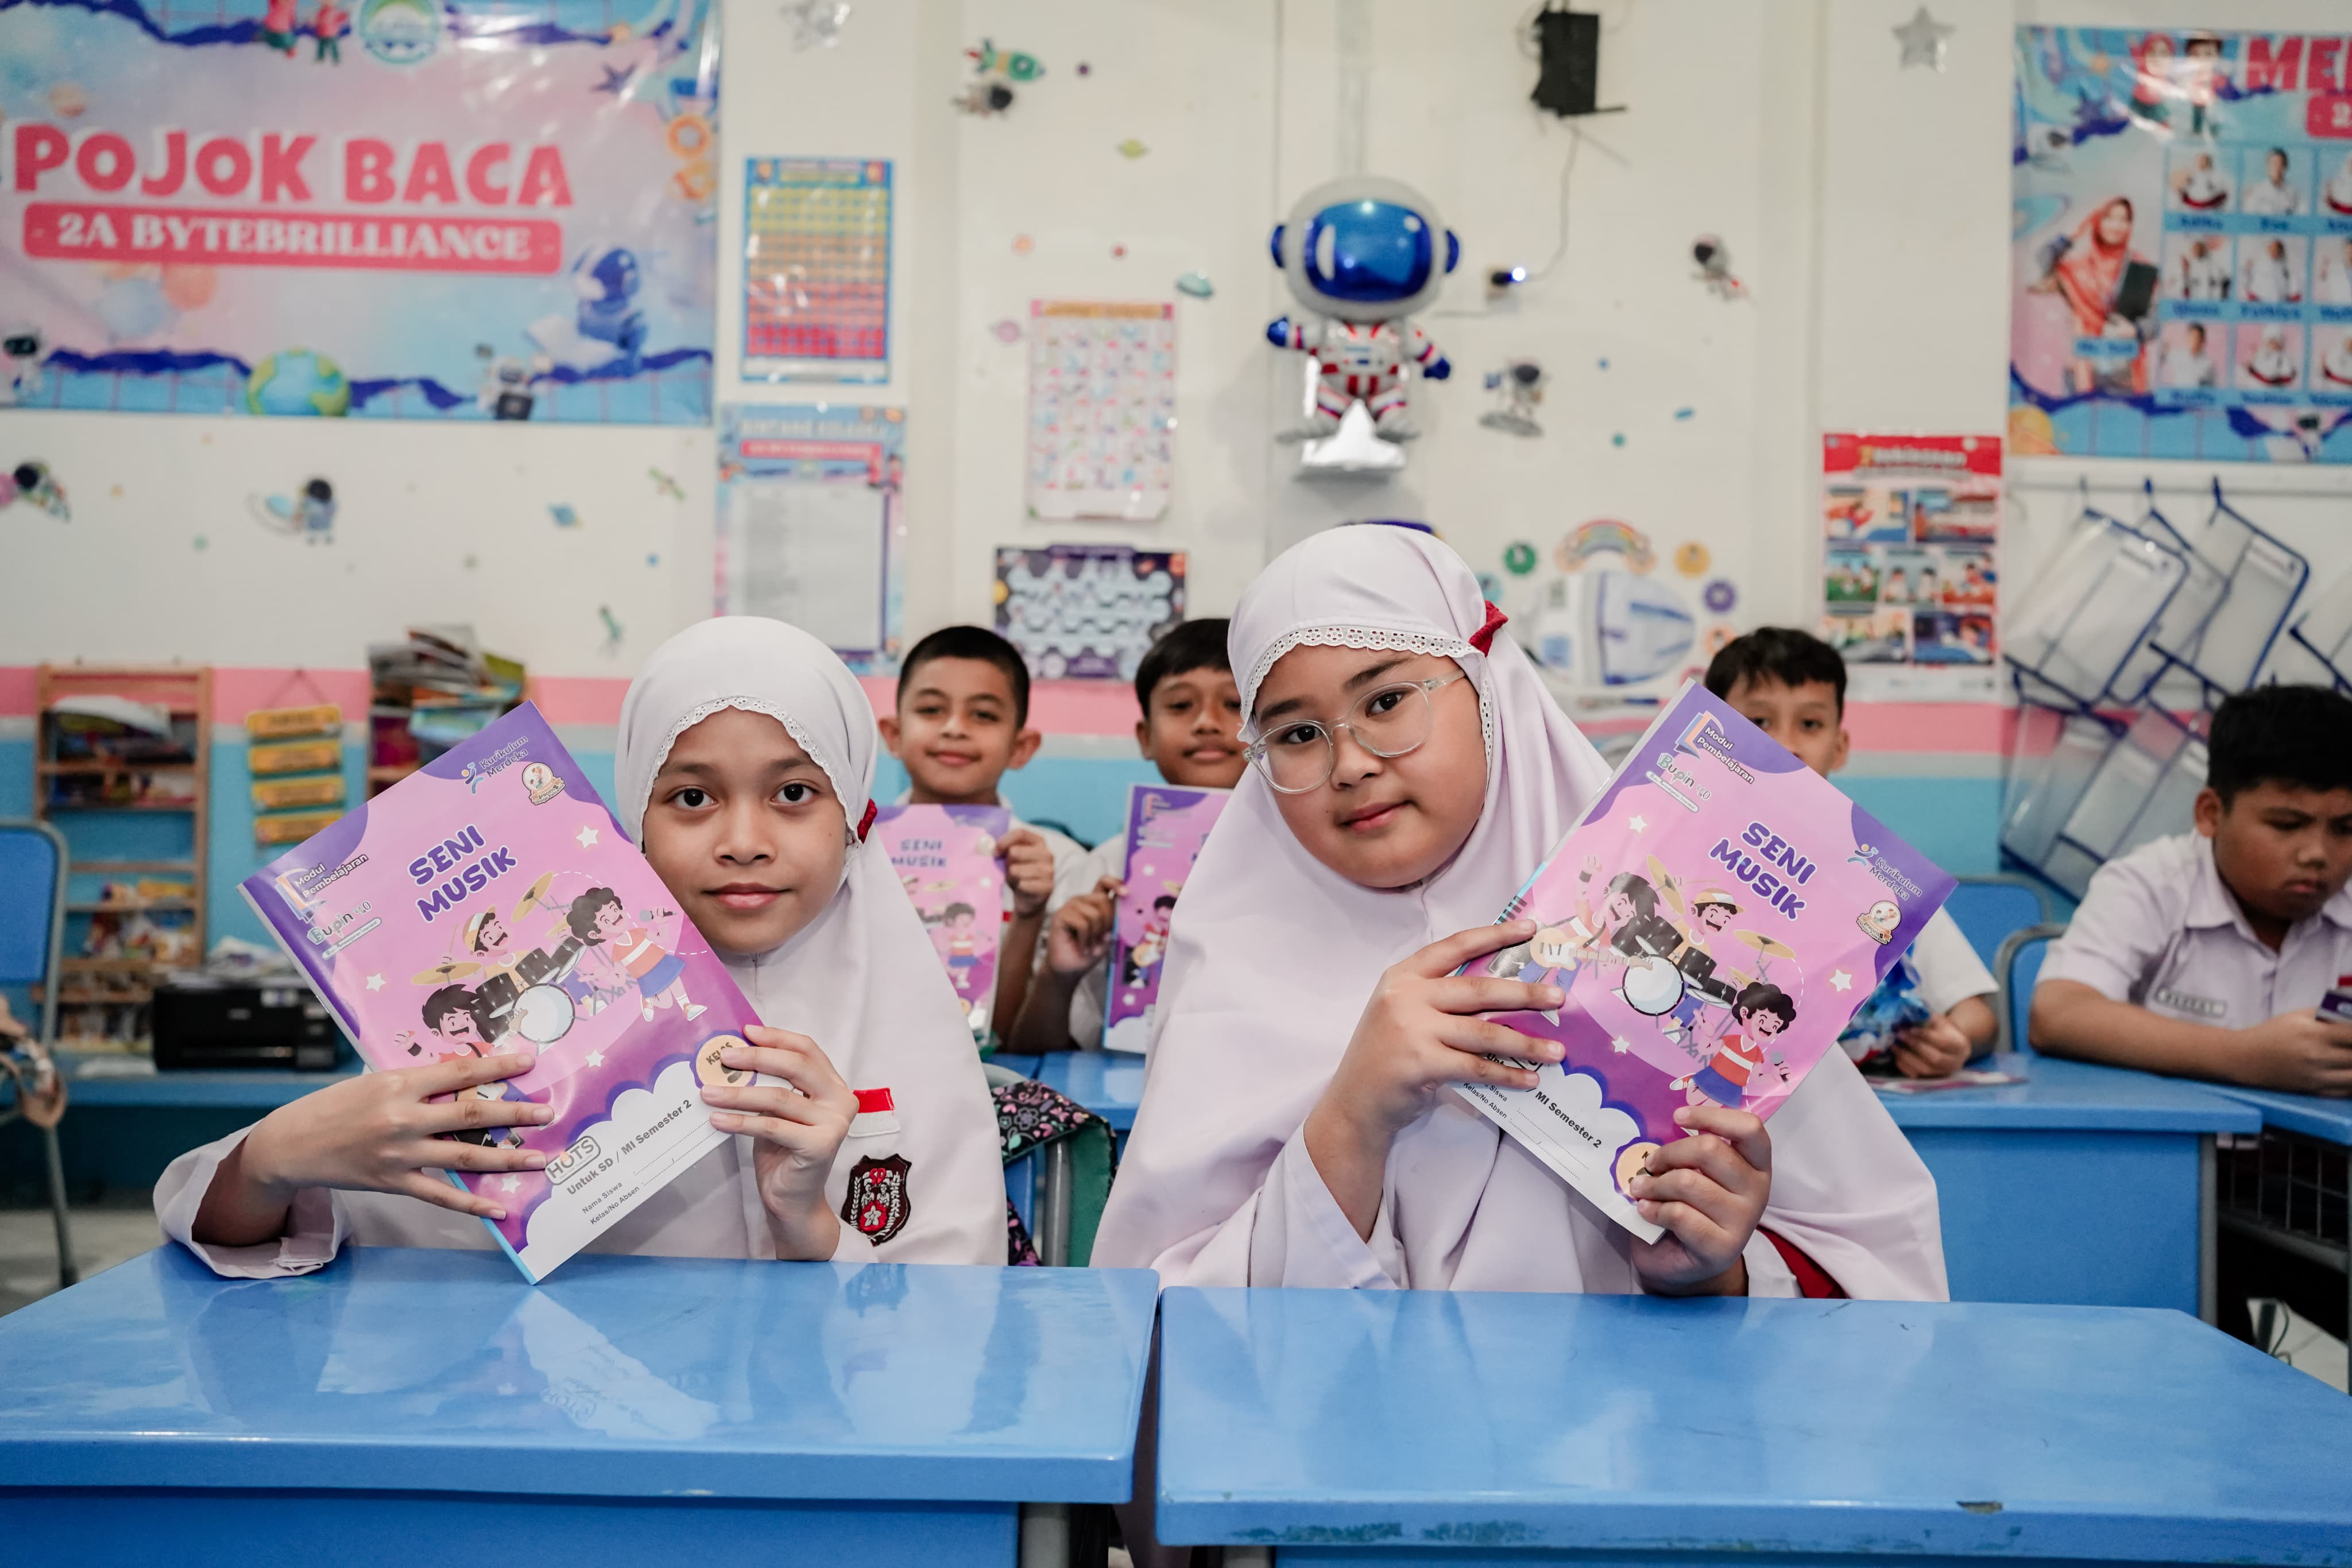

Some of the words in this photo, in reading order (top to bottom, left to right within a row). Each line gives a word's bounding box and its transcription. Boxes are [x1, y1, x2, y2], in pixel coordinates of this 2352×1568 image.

[2246, 37, 2352, 90] ME
[14, 123, 316, 203] POJOK
[345, 138, 572, 207] BACA
[58, 213, 117, 247] 2A
[132, 216, 531, 261] BYTEBRILLIANCE
[479, 735, 528, 768] Kurikulum
[1704, 726, 1735, 750] Modul
[486, 749, 528, 777] Merdeka
[1657, 753, 1696, 788] Bupin
[1696, 737, 1755, 784] Pembelajaran
[409, 825, 485, 885] SENI
[1742, 822, 1816, 885] SENI
[294, 863, 327, 888] Modul
[301, 854, 369, 899] Pembelajaran
[417, 847, 516, 922] MUSIK
[1709, 838, 1805, 919] MUSIK
[1869, 866, 1909, 901] Merdeka
[1875, 857, 1923, 897] Kurikulum
[307, 913, 355, 945] Bupin
[1488, 1102, 1508, 1119] Absen
[1535, 1091, 1550, 1105] MI
[1548, 1102, 1594, 1143] Semester
[1593, 1139, 1602, 1149] 2
[547, 1139, 594, 1179] HOTS
[566, 1170, 599, 1194] Untuk
[598, 1157, 614, 1172] SD
[616, 1151, 620, 1163] /
[621, 1140, 636, 1155] MI
[635, 1106, 683, 1144] Semester
[683, 1099, 692, 1109] 2
[582, 1197, 602, 1214] Nama
[601, 1182, 623, 1199] Siswa
[590, 1201, 619, 1225] Kelas/No
[619, 1186, 640, 1204] Absen
